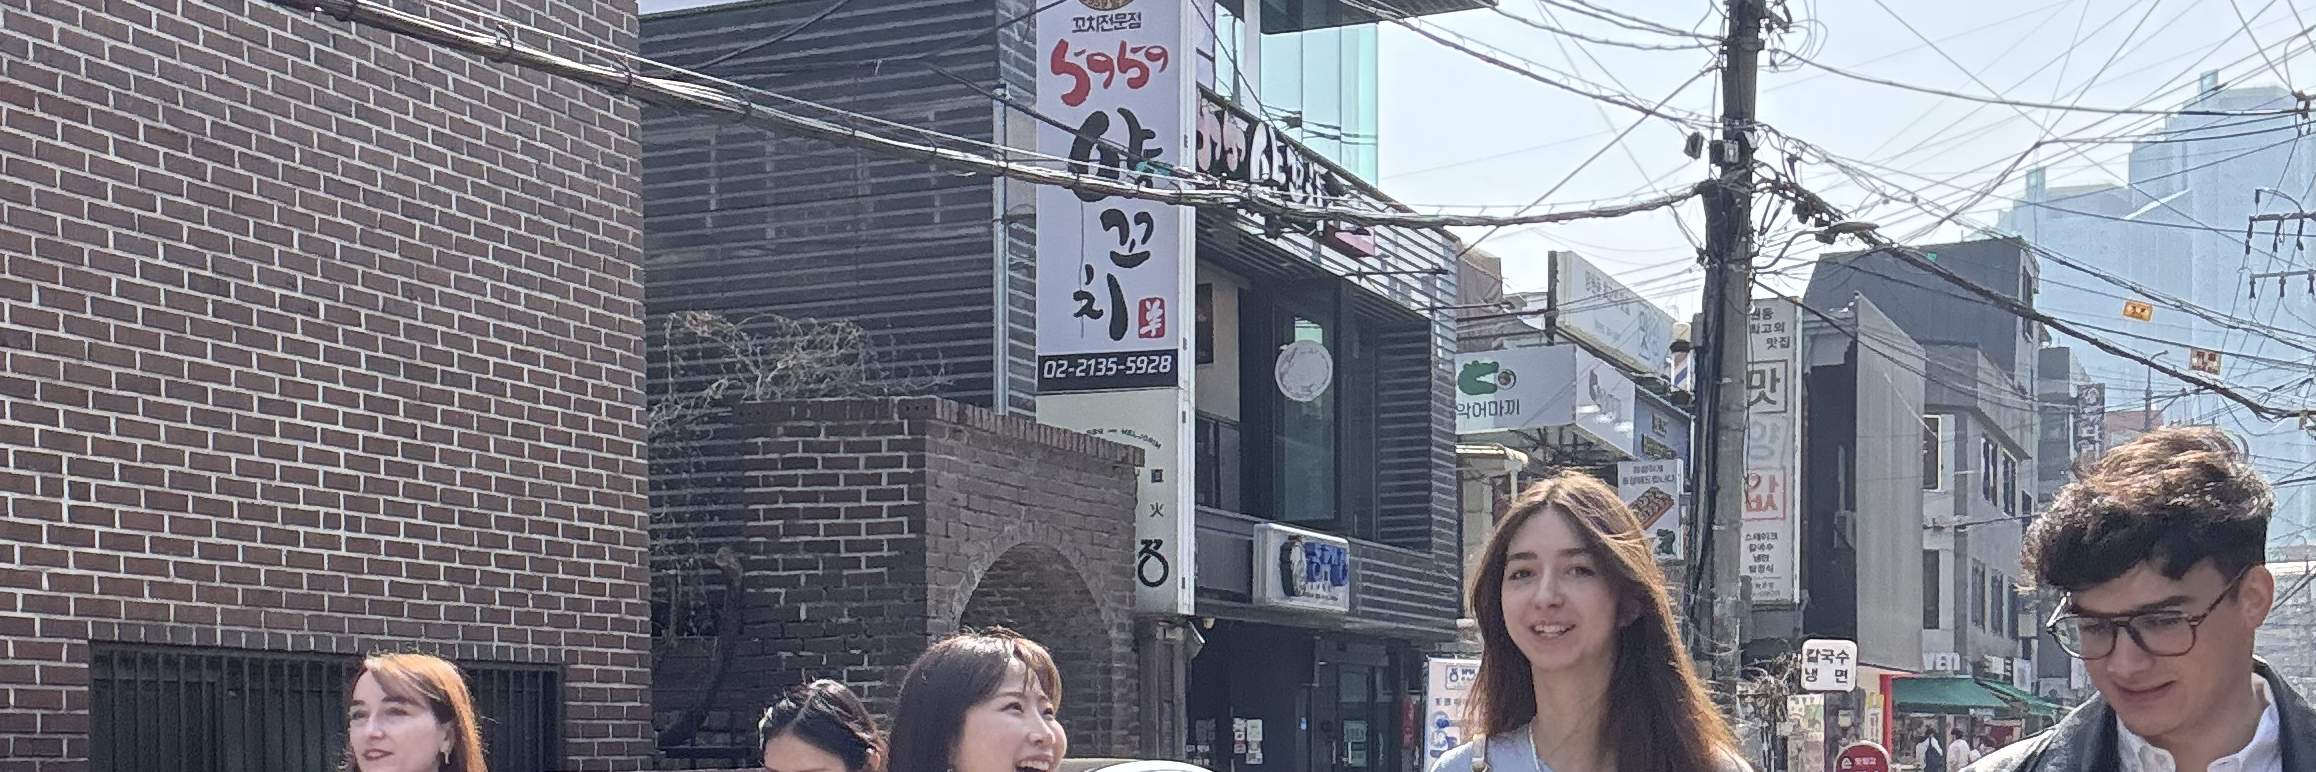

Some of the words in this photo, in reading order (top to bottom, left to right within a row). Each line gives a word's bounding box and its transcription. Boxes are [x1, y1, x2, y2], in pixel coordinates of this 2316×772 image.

[1071, 11, 1142, 34] 꼬치전문점
[1766, 336, 1790, 350] 맛집
[1043, 355, 1172, 379] 02-2135-5928
[1746, 368, 1781, 406] 맛
[1455, 399, 1520, 419] 악어마끼
[1806, 649, 1849, 664] 칼국수
